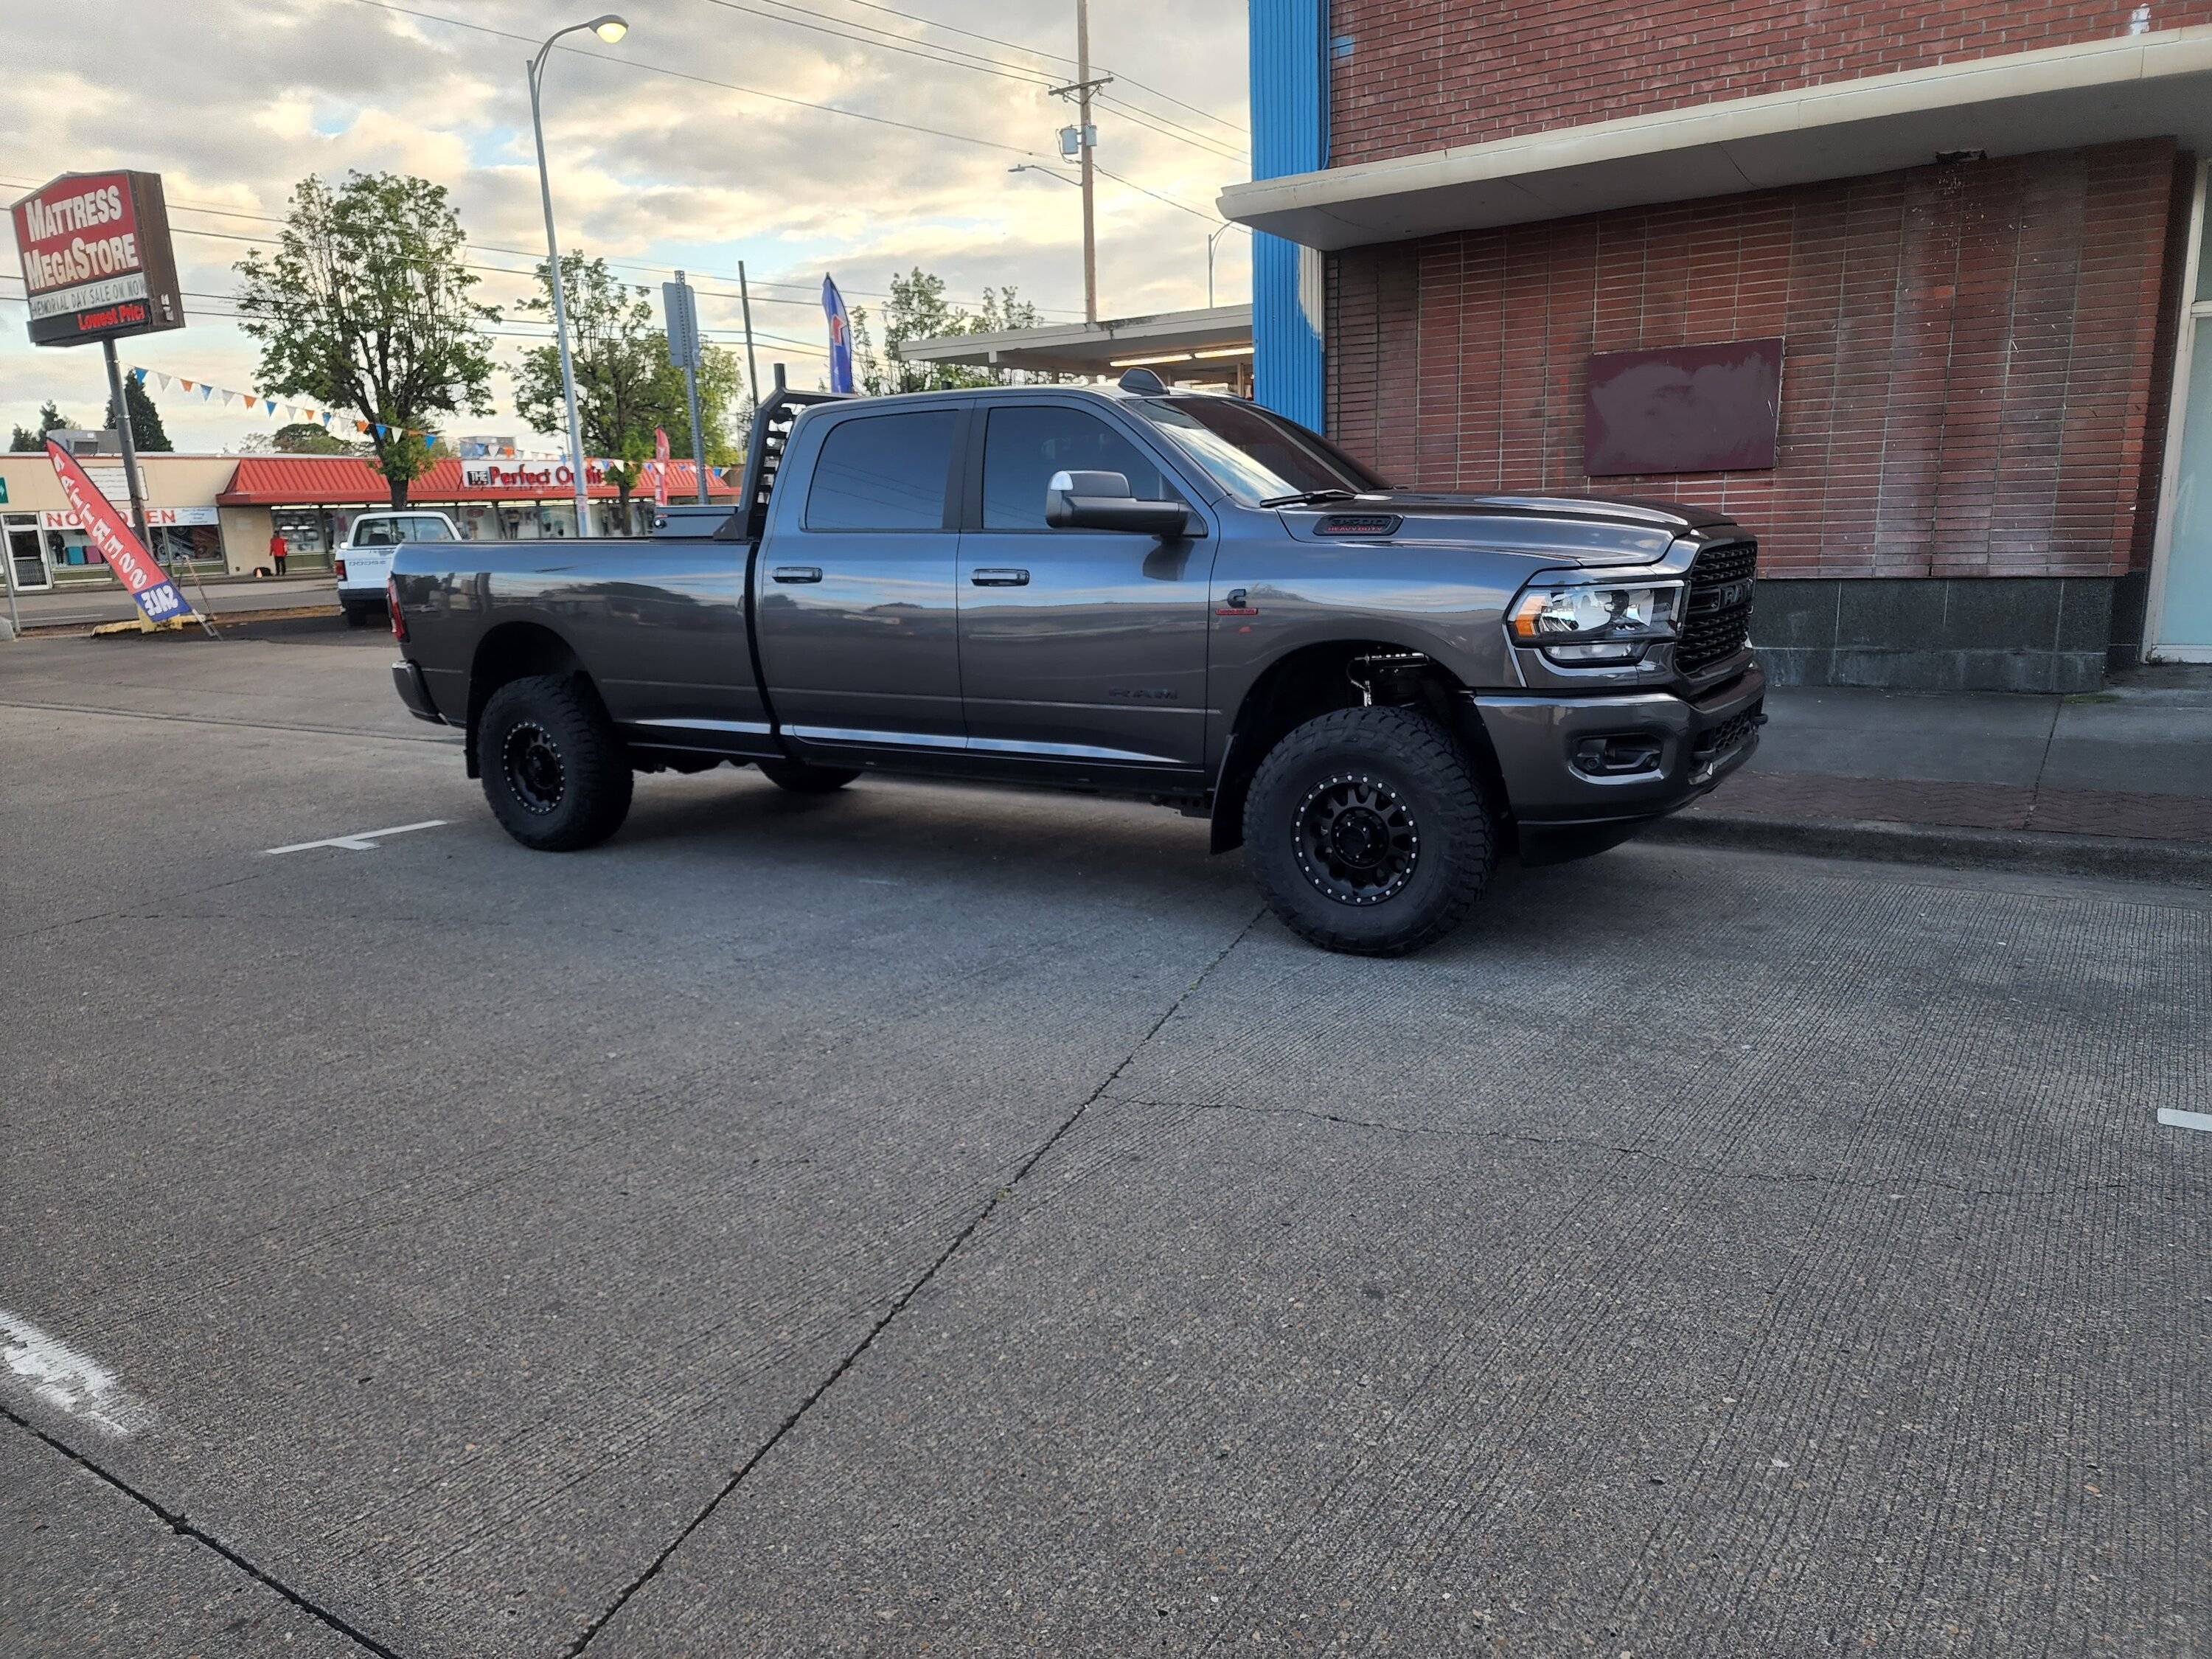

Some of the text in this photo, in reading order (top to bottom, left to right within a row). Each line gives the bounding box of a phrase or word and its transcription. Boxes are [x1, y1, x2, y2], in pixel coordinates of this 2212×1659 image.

[25, 185, 122, 243] MATTRESS
[72, 291, 87, 308] DAY
[89, 285, 111, 305] SALE
[112, 283, 124, 299] ON
[77, 307, 118, 331] Lowest
[470, 470, 488, 485] THE
[489, 463, 551, 486] Perfect
